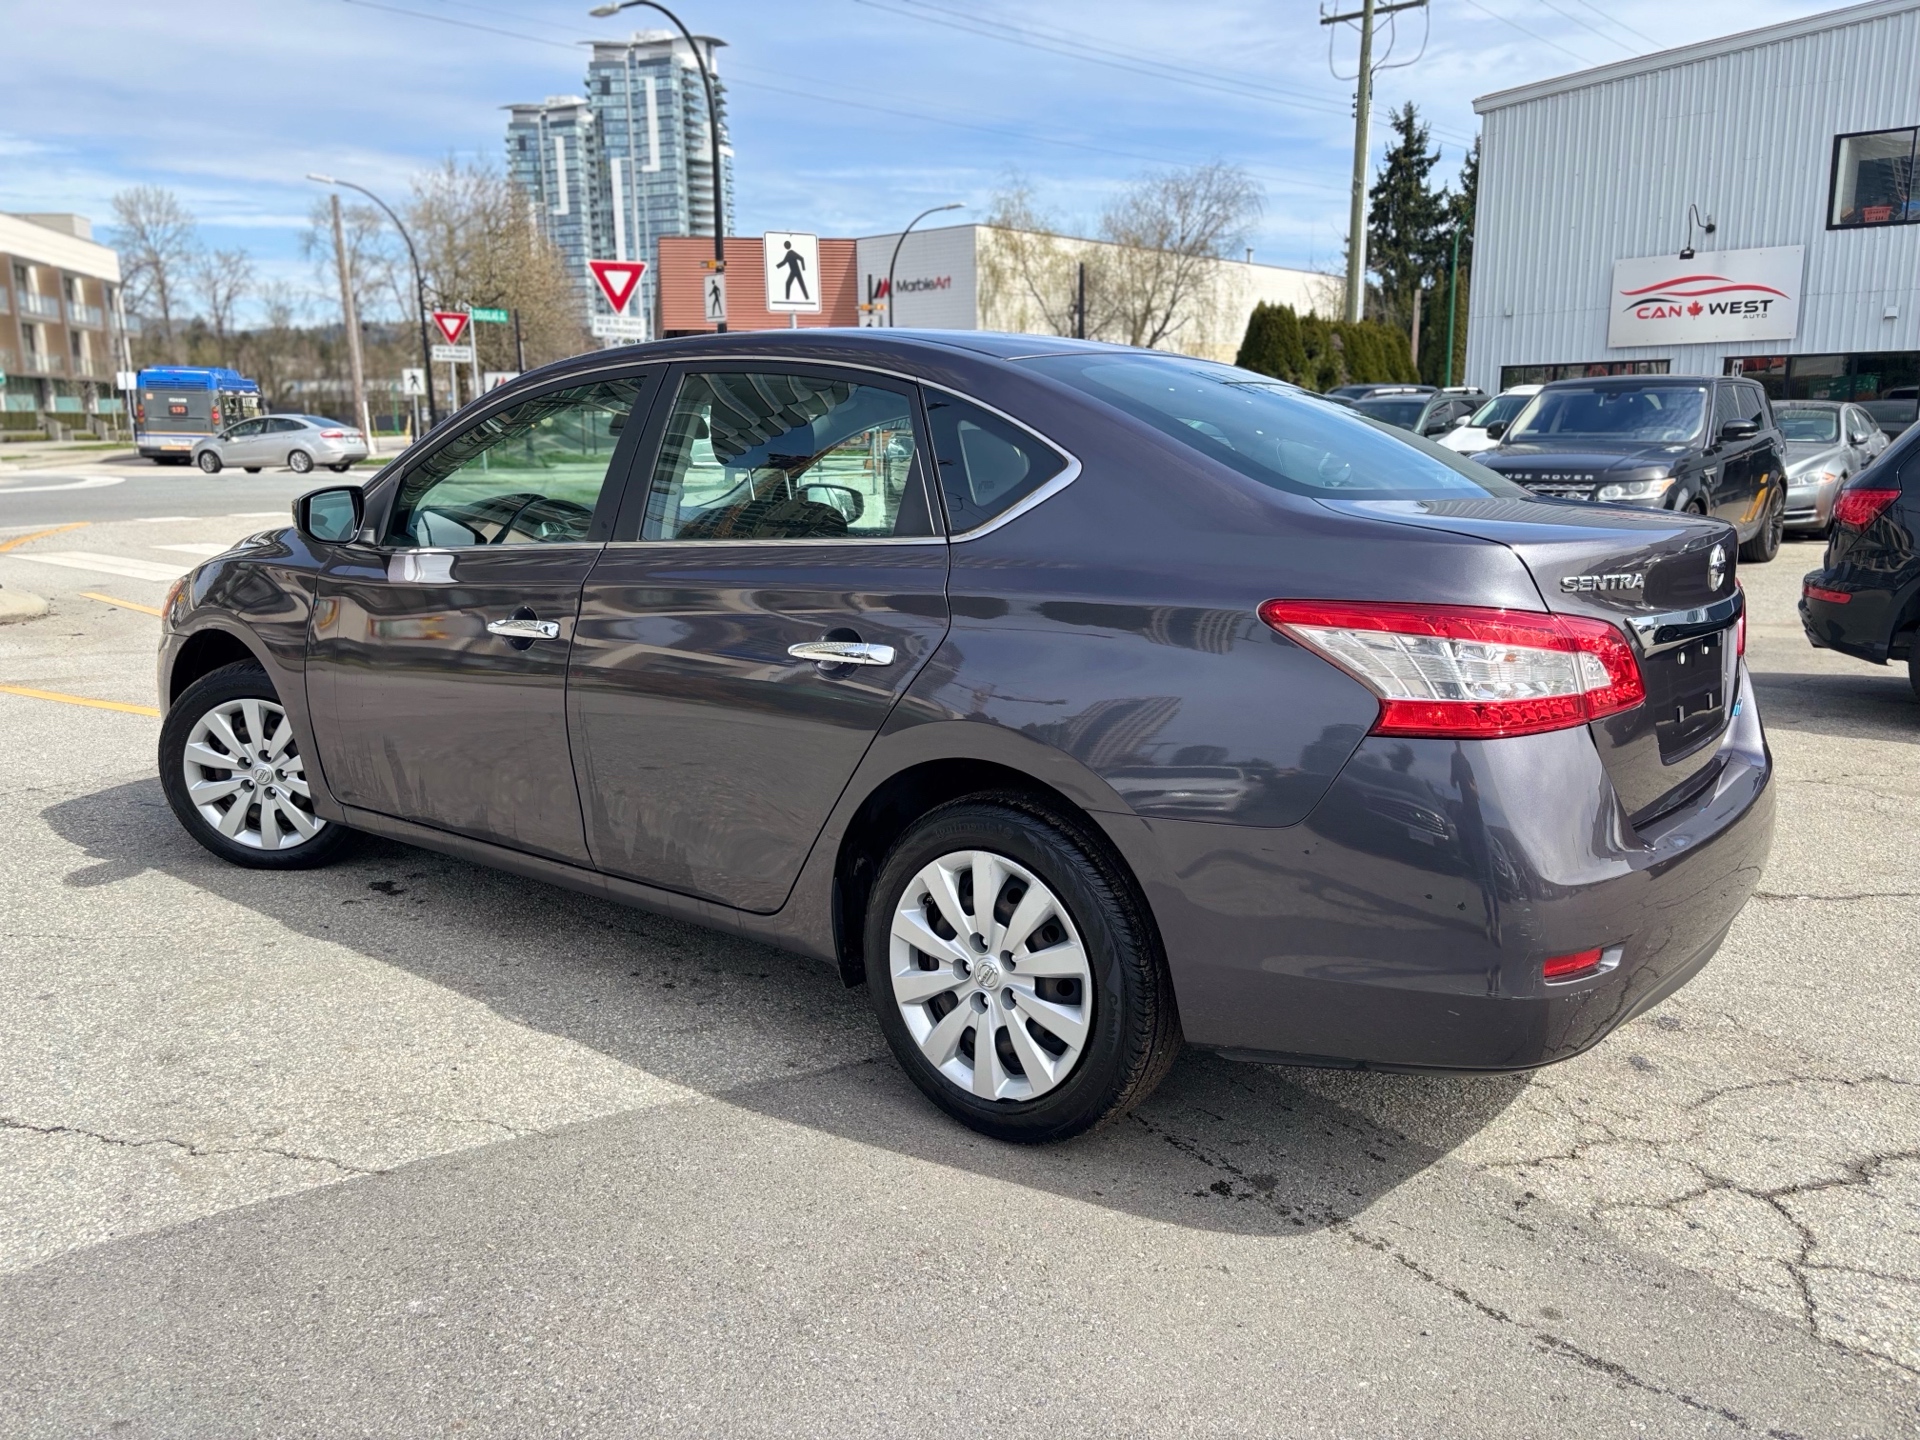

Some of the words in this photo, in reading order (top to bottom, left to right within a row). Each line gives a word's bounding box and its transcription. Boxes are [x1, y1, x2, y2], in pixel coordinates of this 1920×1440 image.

[897, 275, 951, 293] MarbleArt
[1636, 305, 1682, 319] CAN
[1708, 299, 1774, 315] WEST
[1560, 573, 1645, 592] SENTRA
